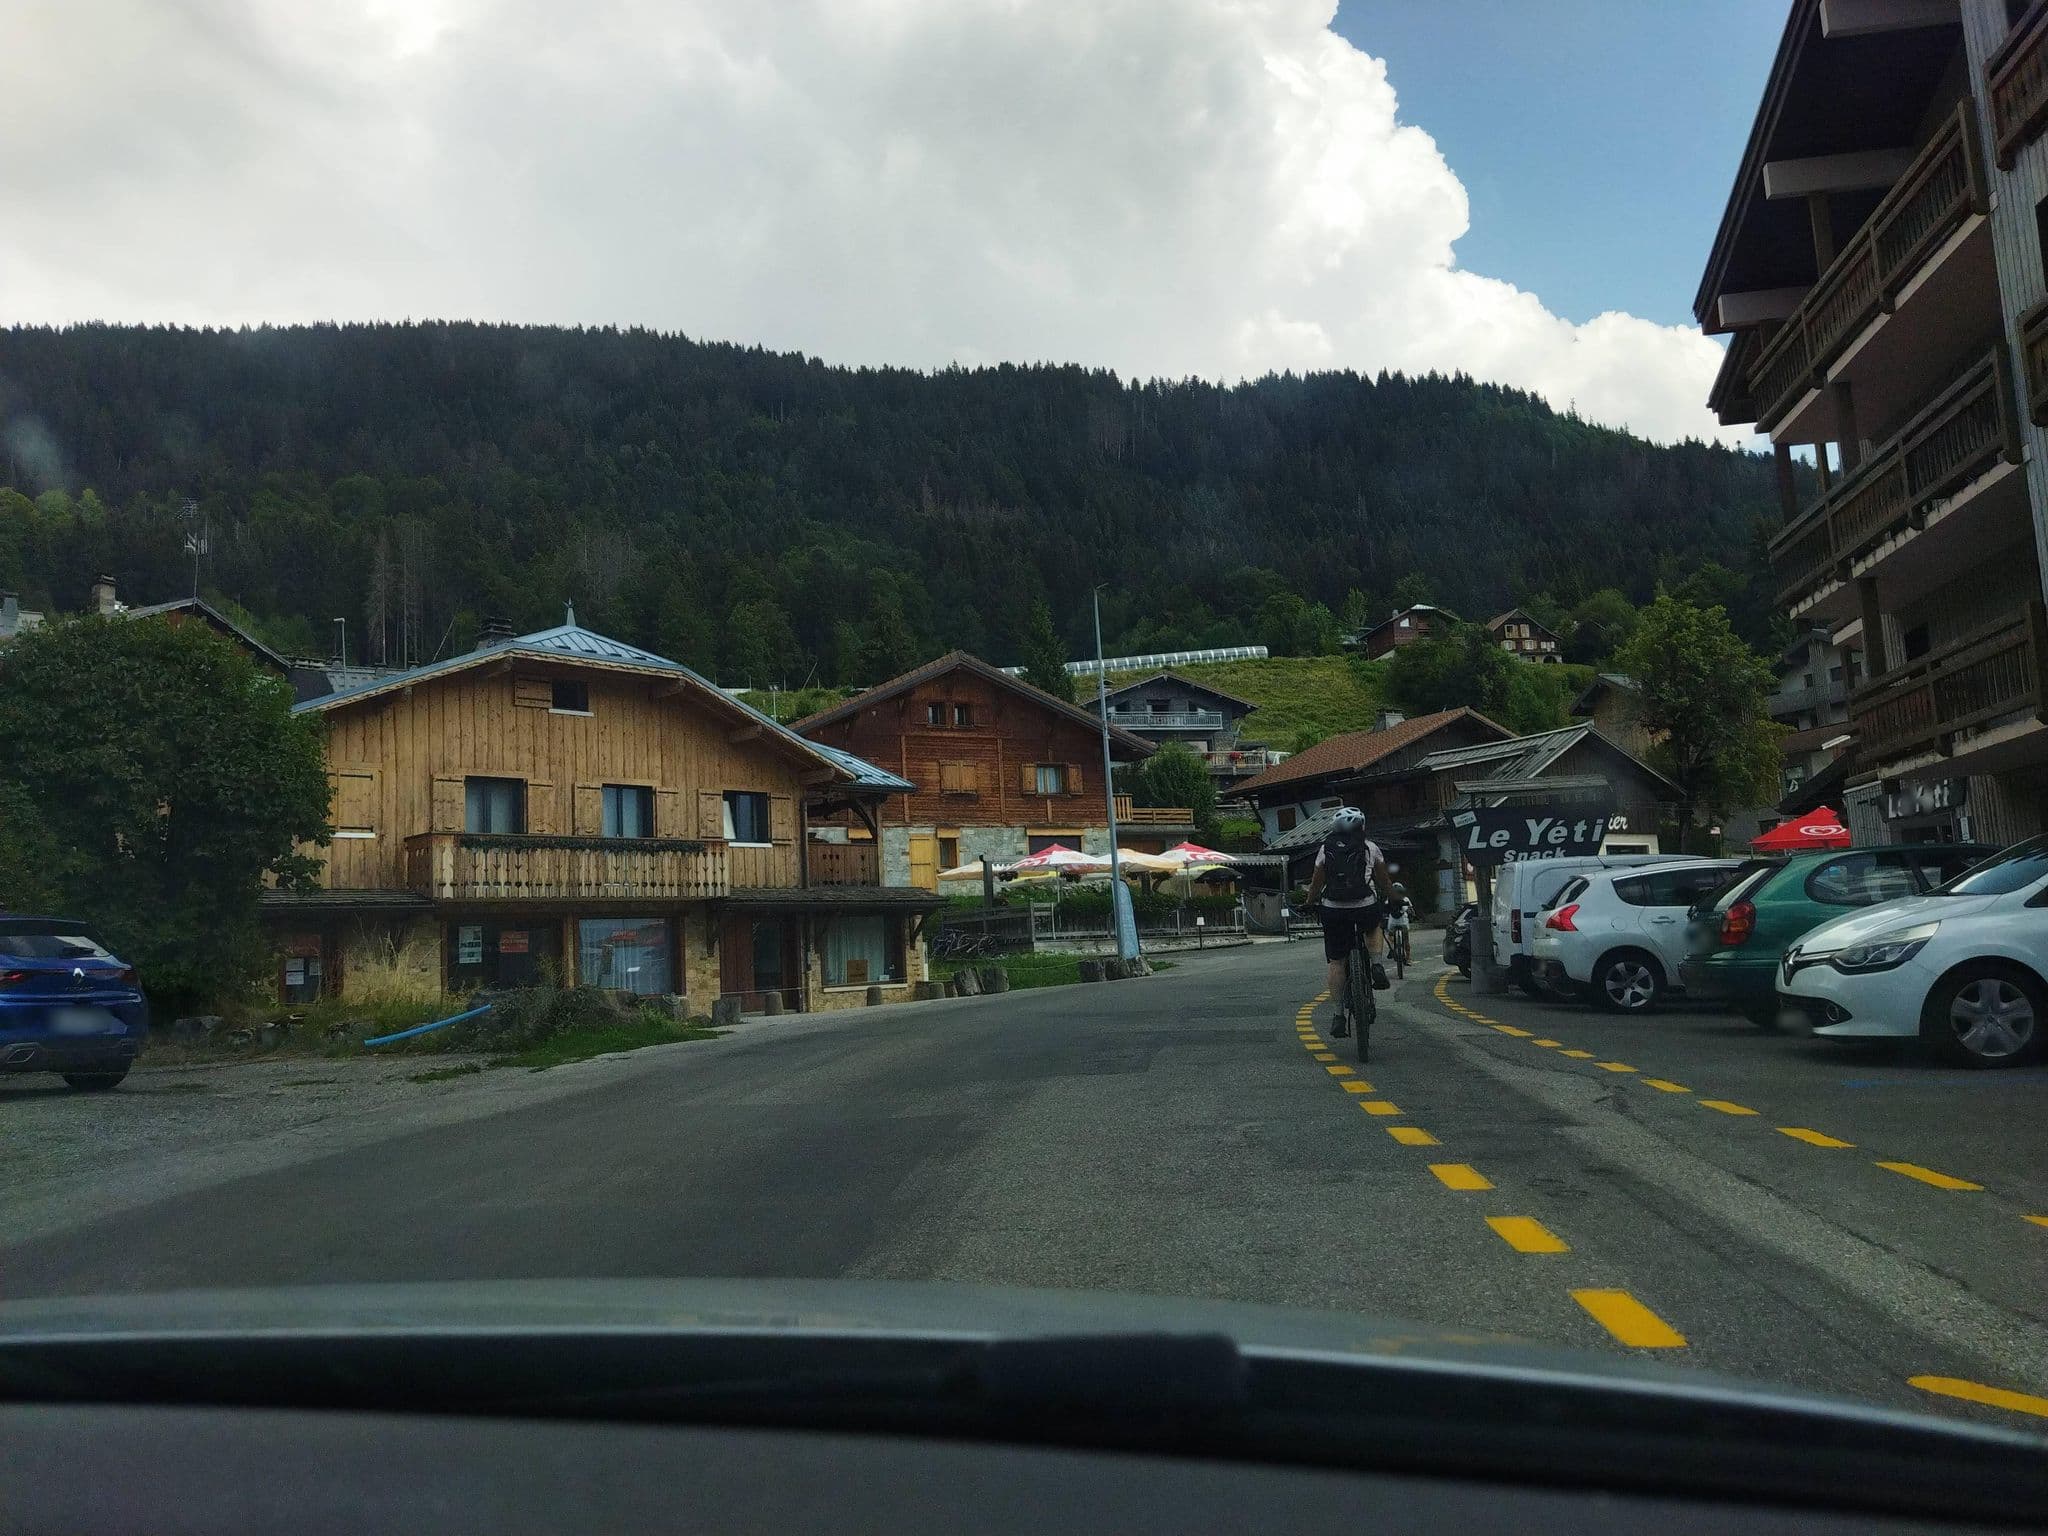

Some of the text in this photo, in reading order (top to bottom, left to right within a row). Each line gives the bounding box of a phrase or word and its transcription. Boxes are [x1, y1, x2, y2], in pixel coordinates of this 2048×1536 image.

[1468, 818, 1603, 848] Le Yéti
[1504, 847, 1566, 862] Snack
